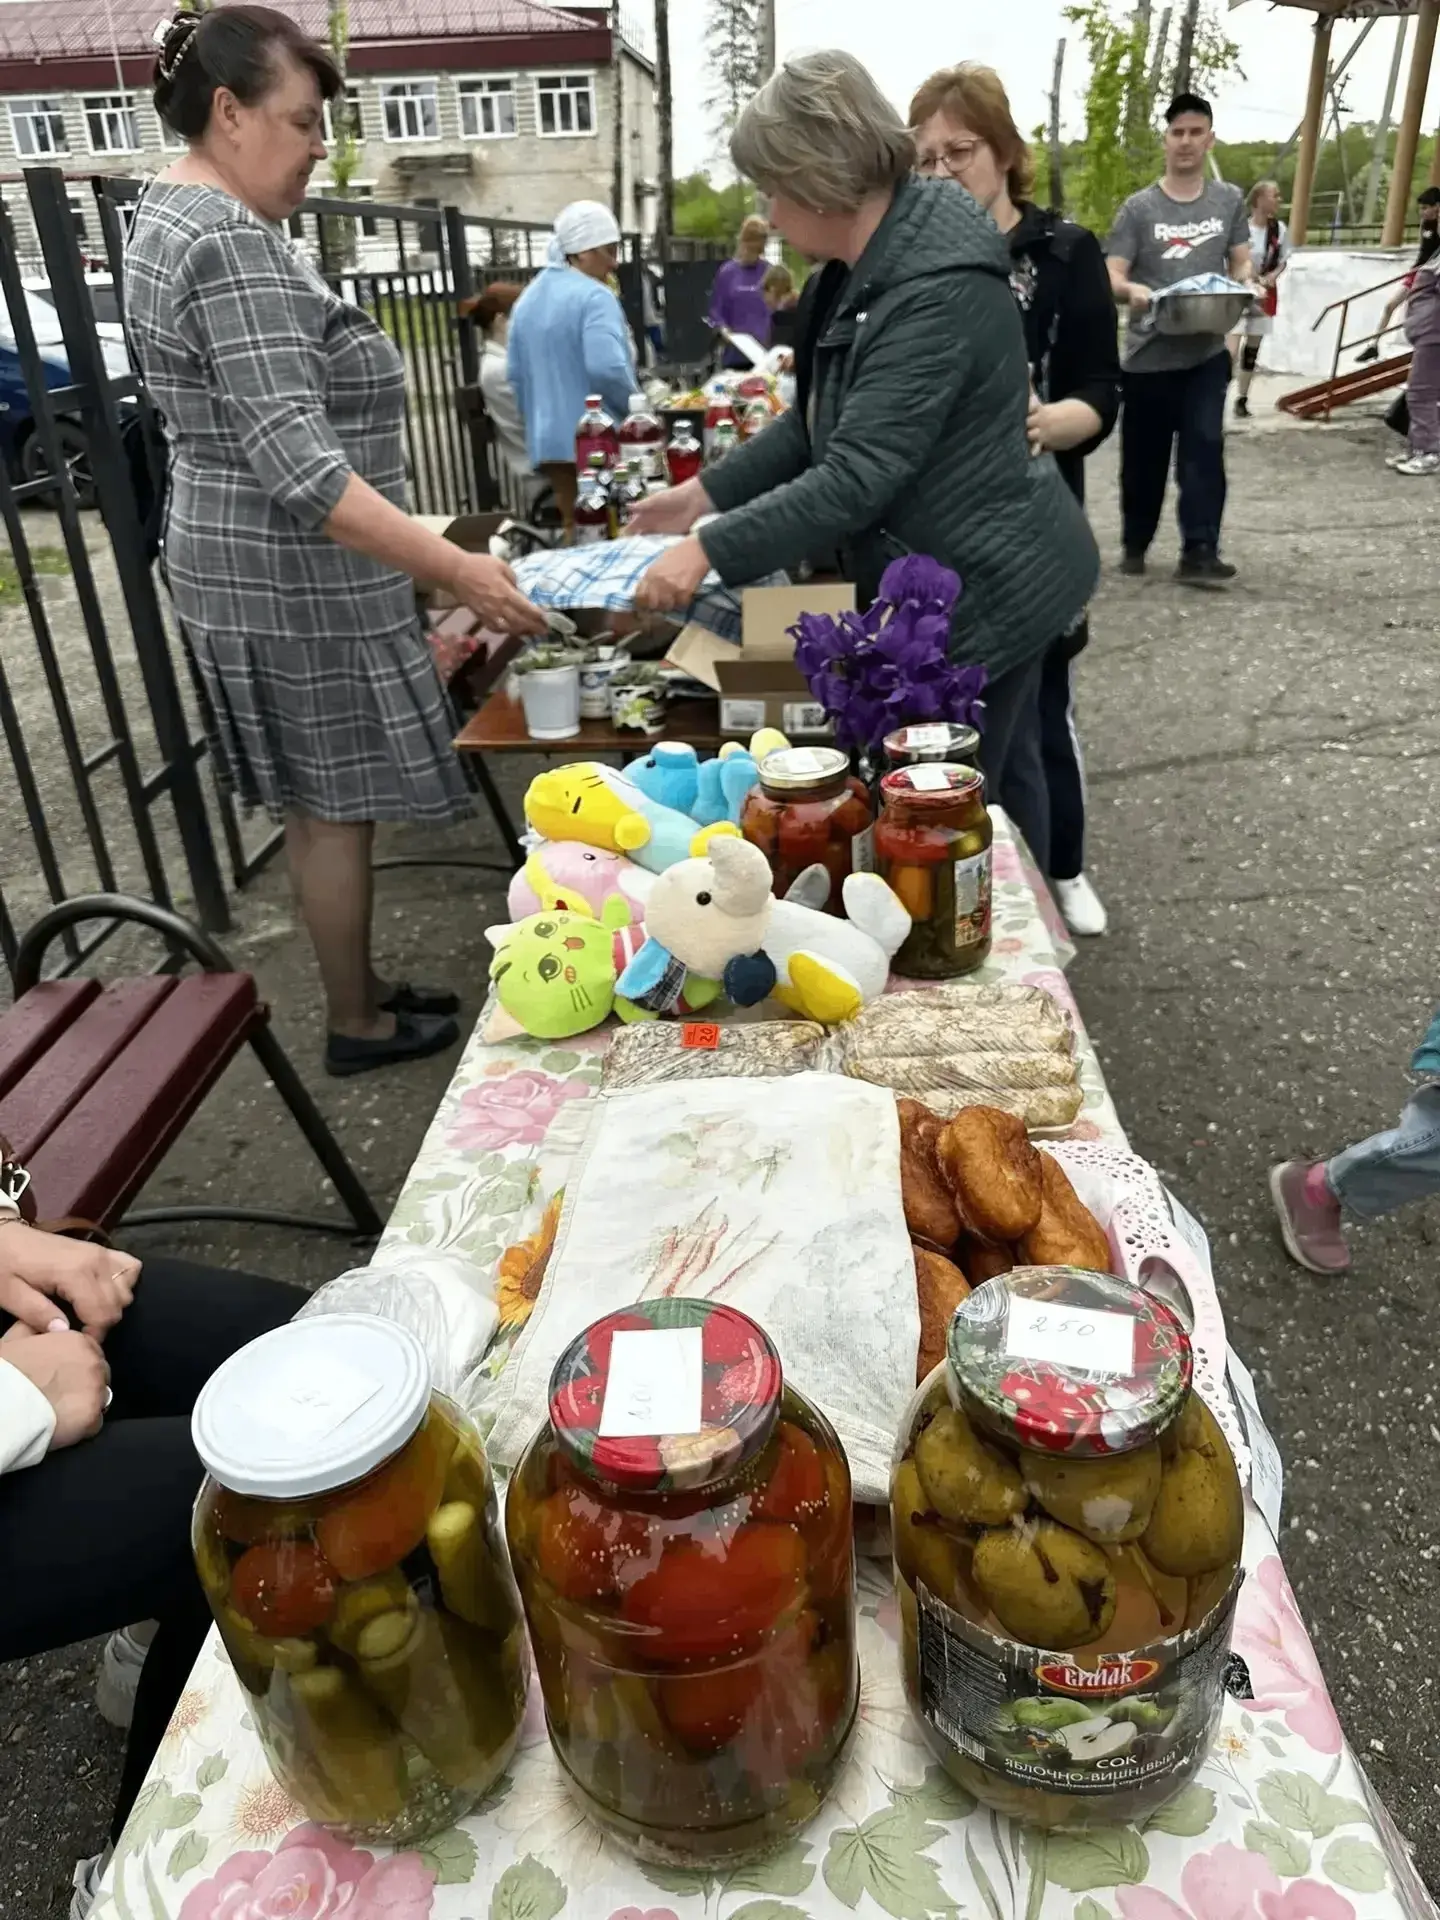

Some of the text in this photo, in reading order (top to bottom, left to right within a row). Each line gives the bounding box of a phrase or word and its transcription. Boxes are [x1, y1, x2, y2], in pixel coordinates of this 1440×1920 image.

[1153, 217, 1224, 242] Reebok
[1029, 1316, 1096, 1336] 250
[1096, 1754, 1138, 1769] СОК
